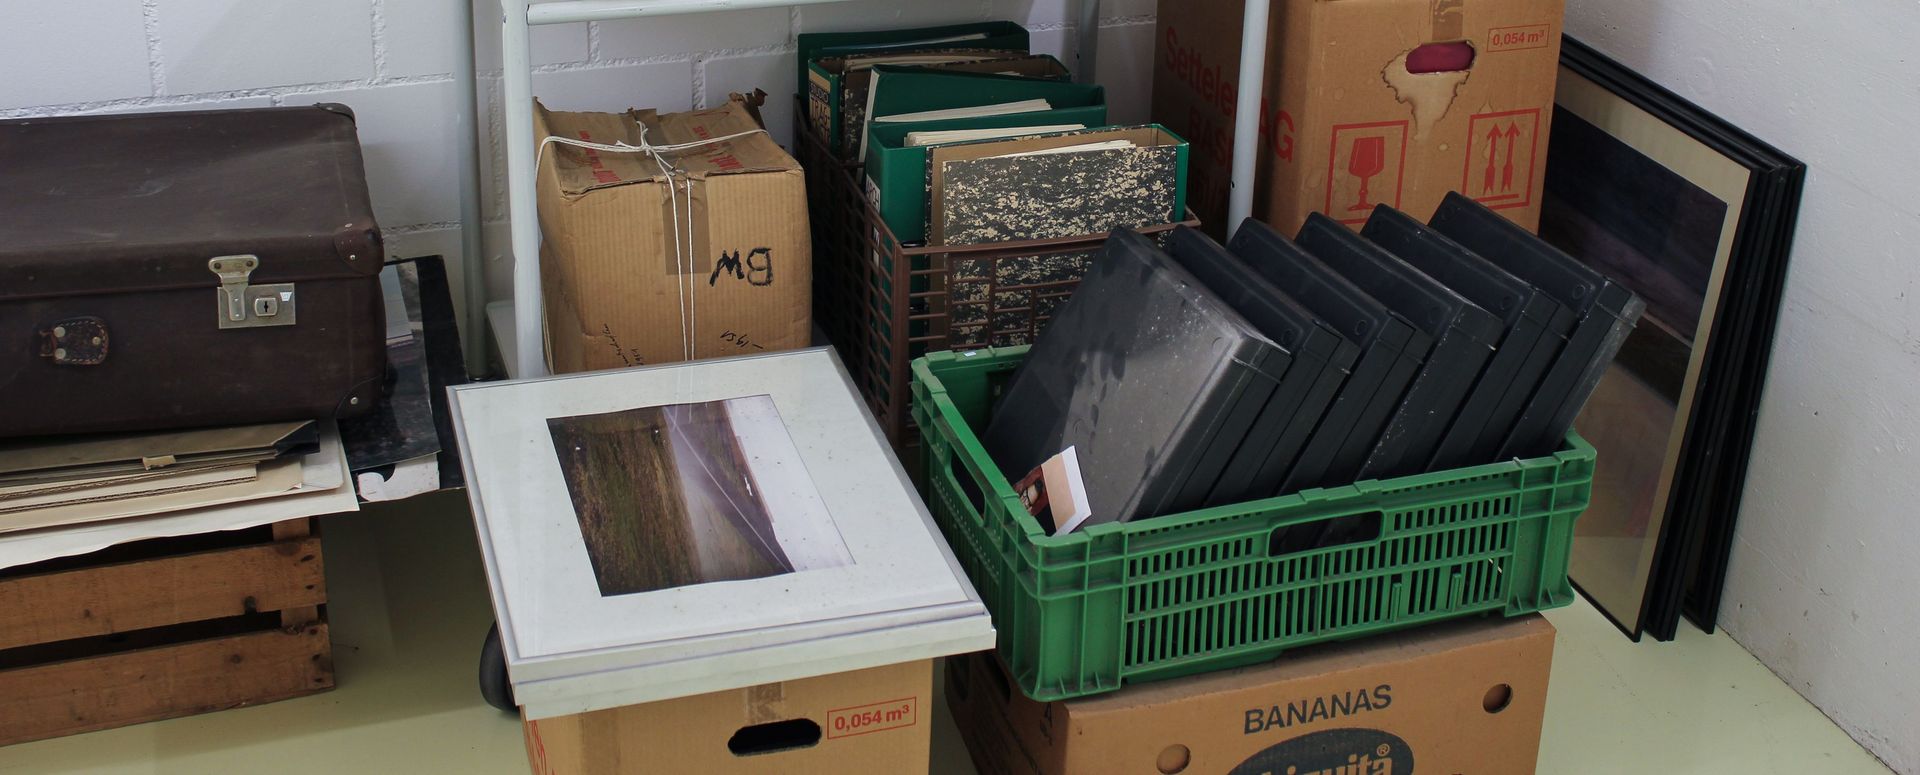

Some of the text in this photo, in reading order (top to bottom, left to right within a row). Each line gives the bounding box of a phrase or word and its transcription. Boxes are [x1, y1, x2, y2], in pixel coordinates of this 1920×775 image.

[1492, 30, 1545, 47] 0,054 m³
[1166, 26, 1237, 118] Settele
[709, 247, 774, 287] BW
[834, 704, 910, 732] 0,054 m³
[1244, 684, 1392, 735] BANANAS
